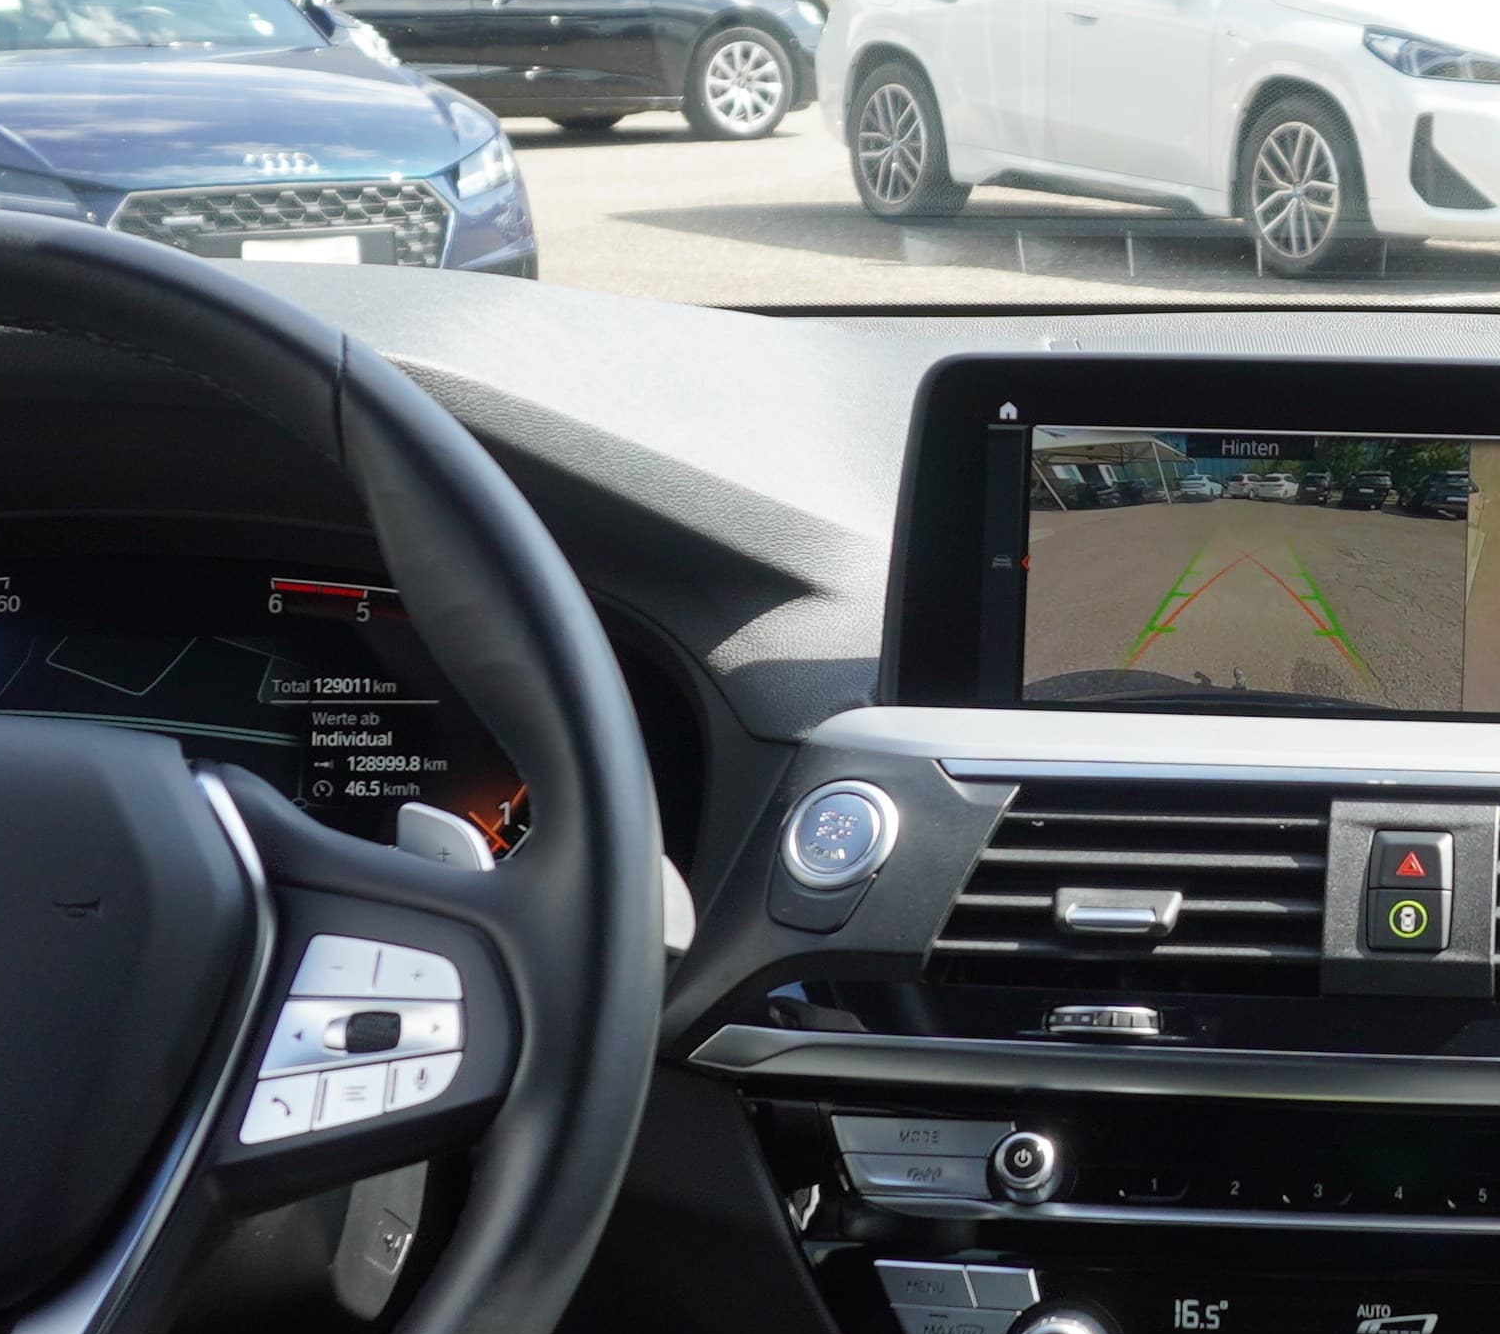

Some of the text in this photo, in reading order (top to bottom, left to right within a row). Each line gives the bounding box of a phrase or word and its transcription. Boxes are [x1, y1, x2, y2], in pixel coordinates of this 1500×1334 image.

[1221, 438, 1280, 457] Hinten
[268, 593, 283, 614] 6
[356, 601, 371, 622] 5
[271, 678, 397, 694] Total 129011 km
[311, 711, 380, 726] Werte ab
[311, 731, 393, 747] Individual
[346, 756, 447, 772] 128999.8 km
[344, 780, 420, 797] 46.5 km/h
[499, 801, 511, 825] 1
[1150, 1178, 1158, 1192] 1
[1230, 1180, 1241, 1196] 2
[1313, 1183, 1324, 1198] 3
[1394, 1186, 1403, 1200] 4
[1478, 1188, 1488, 1203] 5
[1356, 1304, 1391, 1318] AUTO
